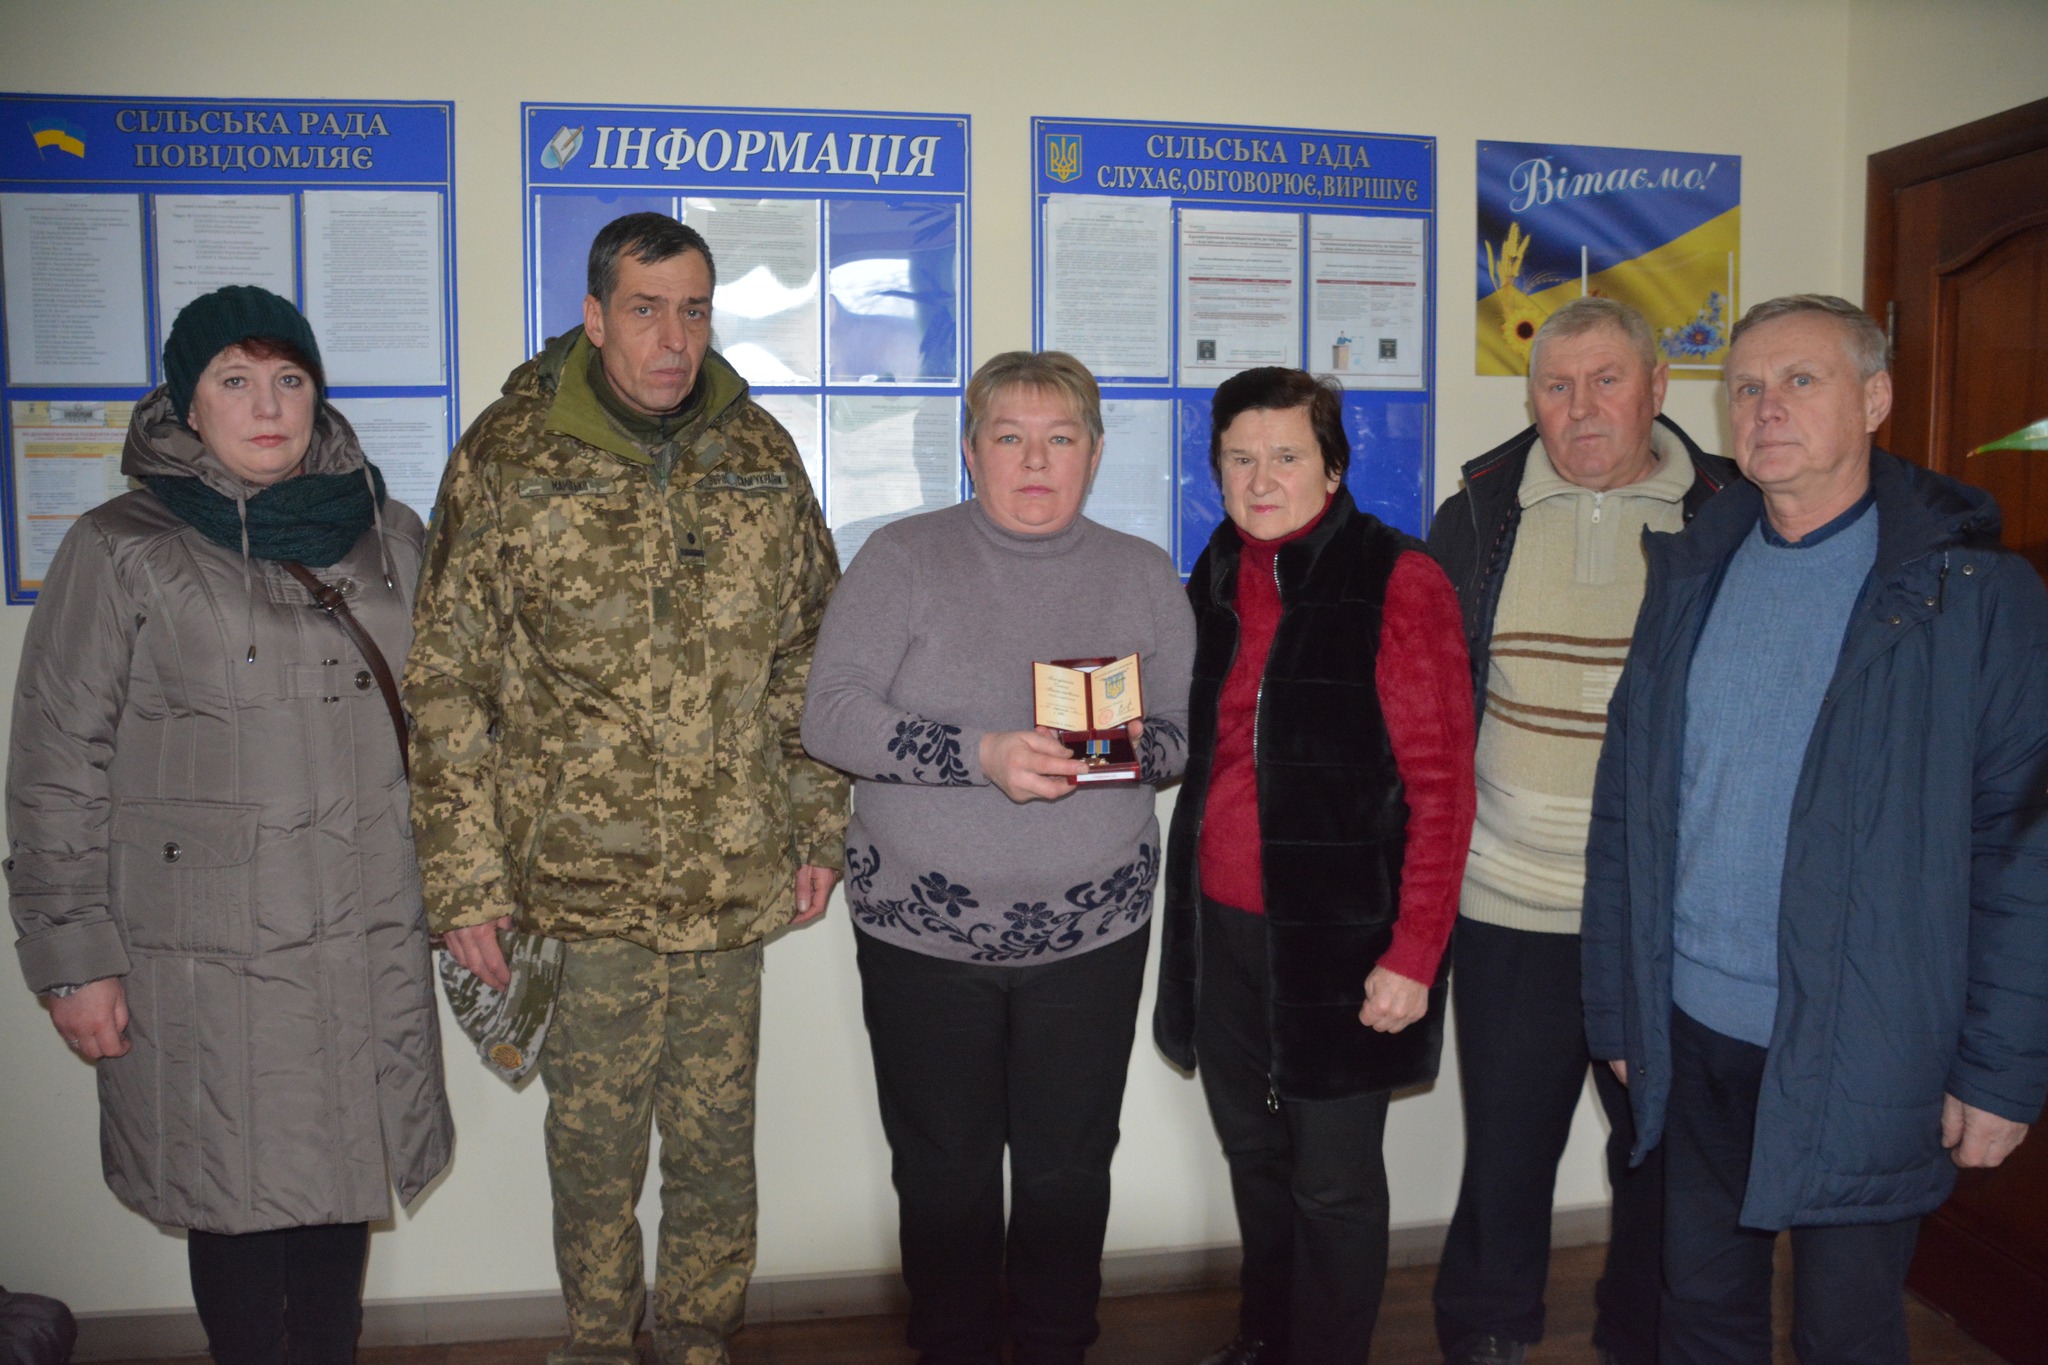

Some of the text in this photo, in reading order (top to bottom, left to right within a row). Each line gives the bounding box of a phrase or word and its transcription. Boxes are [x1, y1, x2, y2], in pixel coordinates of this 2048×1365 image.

[115, 109, 391, 140] СІЛЬСЬКА РАДА
[133, 144, 375, 172] ПОВІДОМЛЯЄ
[589, 126, 942, 185] ІНФОРМАЦІЯ
[1146, 134, 1372, 171] СІЛЬСЬКА РАДА
[1509, 156, 1718, 213] Вітаємо!
